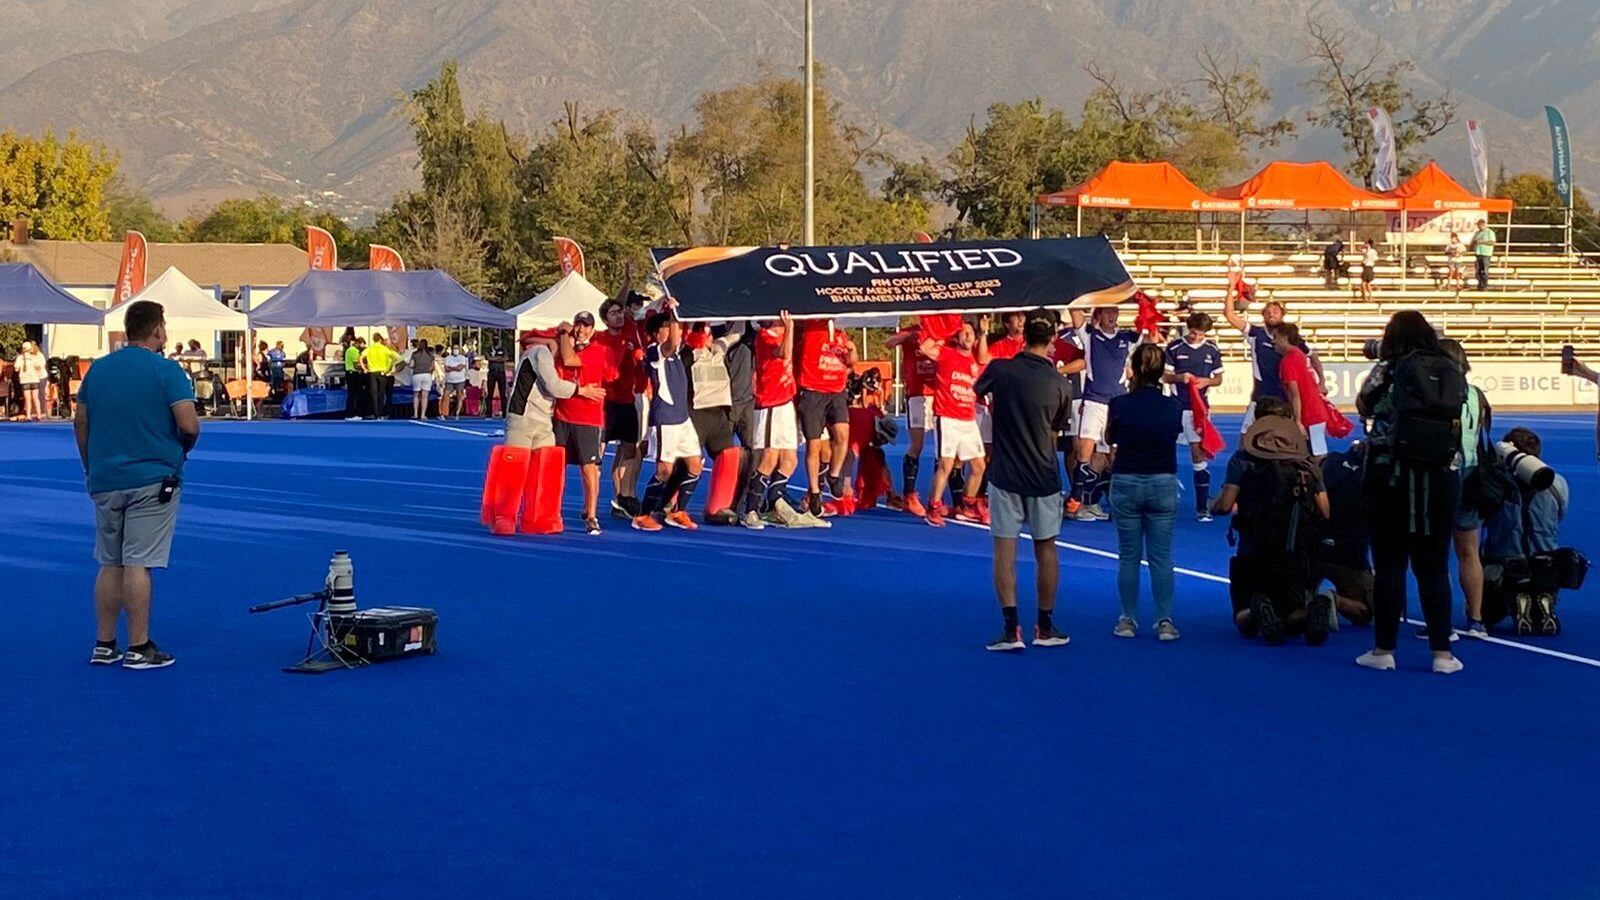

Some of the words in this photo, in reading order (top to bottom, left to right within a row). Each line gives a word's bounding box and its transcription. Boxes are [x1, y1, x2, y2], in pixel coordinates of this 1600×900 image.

[765, 247, 1023, 277] QUALIFIED
[815, 287, 863, 296] HOCKEY
[866, 286, 902, 295] MEN'S
[903, 284, 947, 294] WORLD
[948, 281, 973, 291] CUP
[974, 279, 1001, 289] 2023
[892, 277, 938, 286] ODISHA
[830, 293, 921, 303] BHUBANESWAR
[930, 288, 994, 300] ROURKELA
[1519, 376, 1560, 391] BICE
